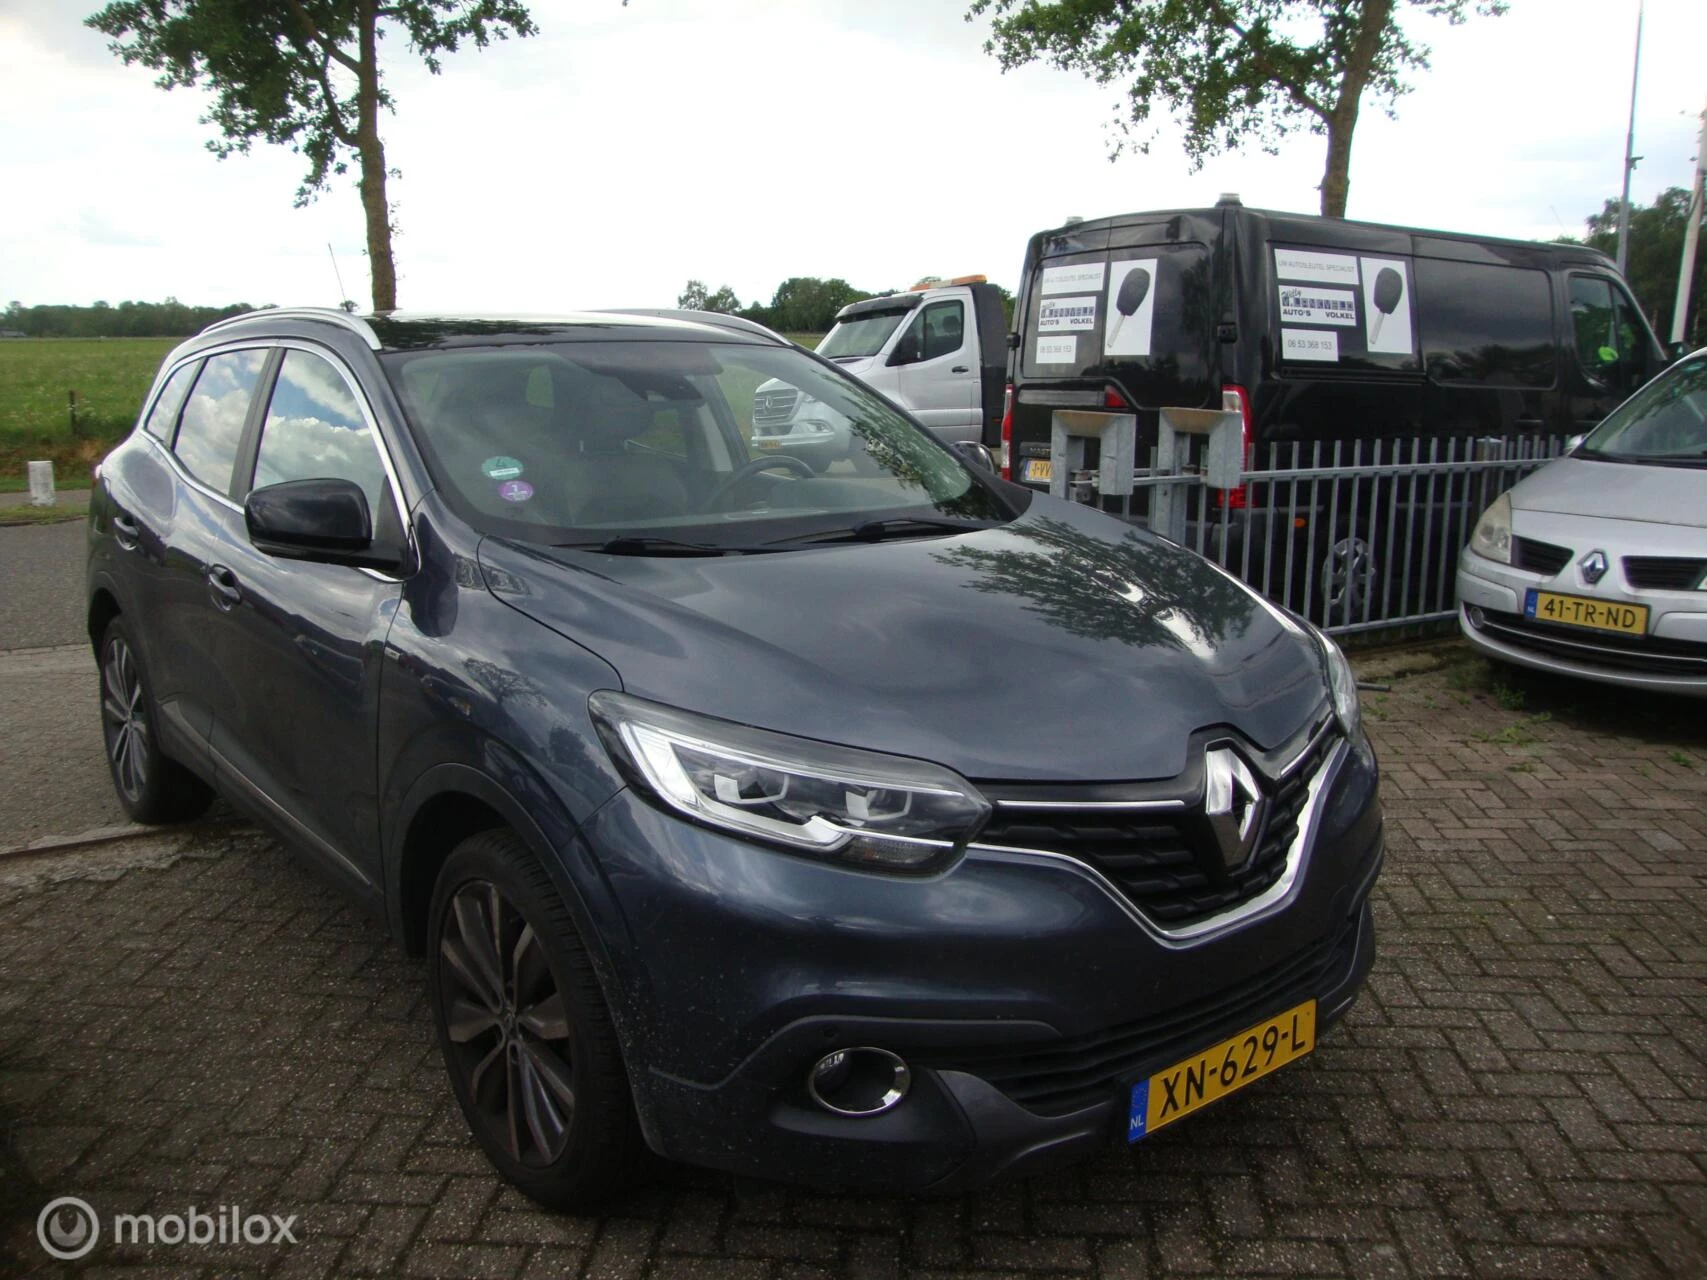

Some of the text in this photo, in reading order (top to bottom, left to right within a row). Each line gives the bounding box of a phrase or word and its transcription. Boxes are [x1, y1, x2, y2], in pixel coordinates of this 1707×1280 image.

[1283, 309, 1355, 320] AUTO'S VOLKEL
[1070, 317, 1093, 325] VOLKEL
[1288, 339, 1296, 348] 06
[1297, 339, 1306, 349] 53
[1543, 598, 1636, 628] 41-TR-ND
[1129, 1014, 1306, 1131] NL XN-629-L
